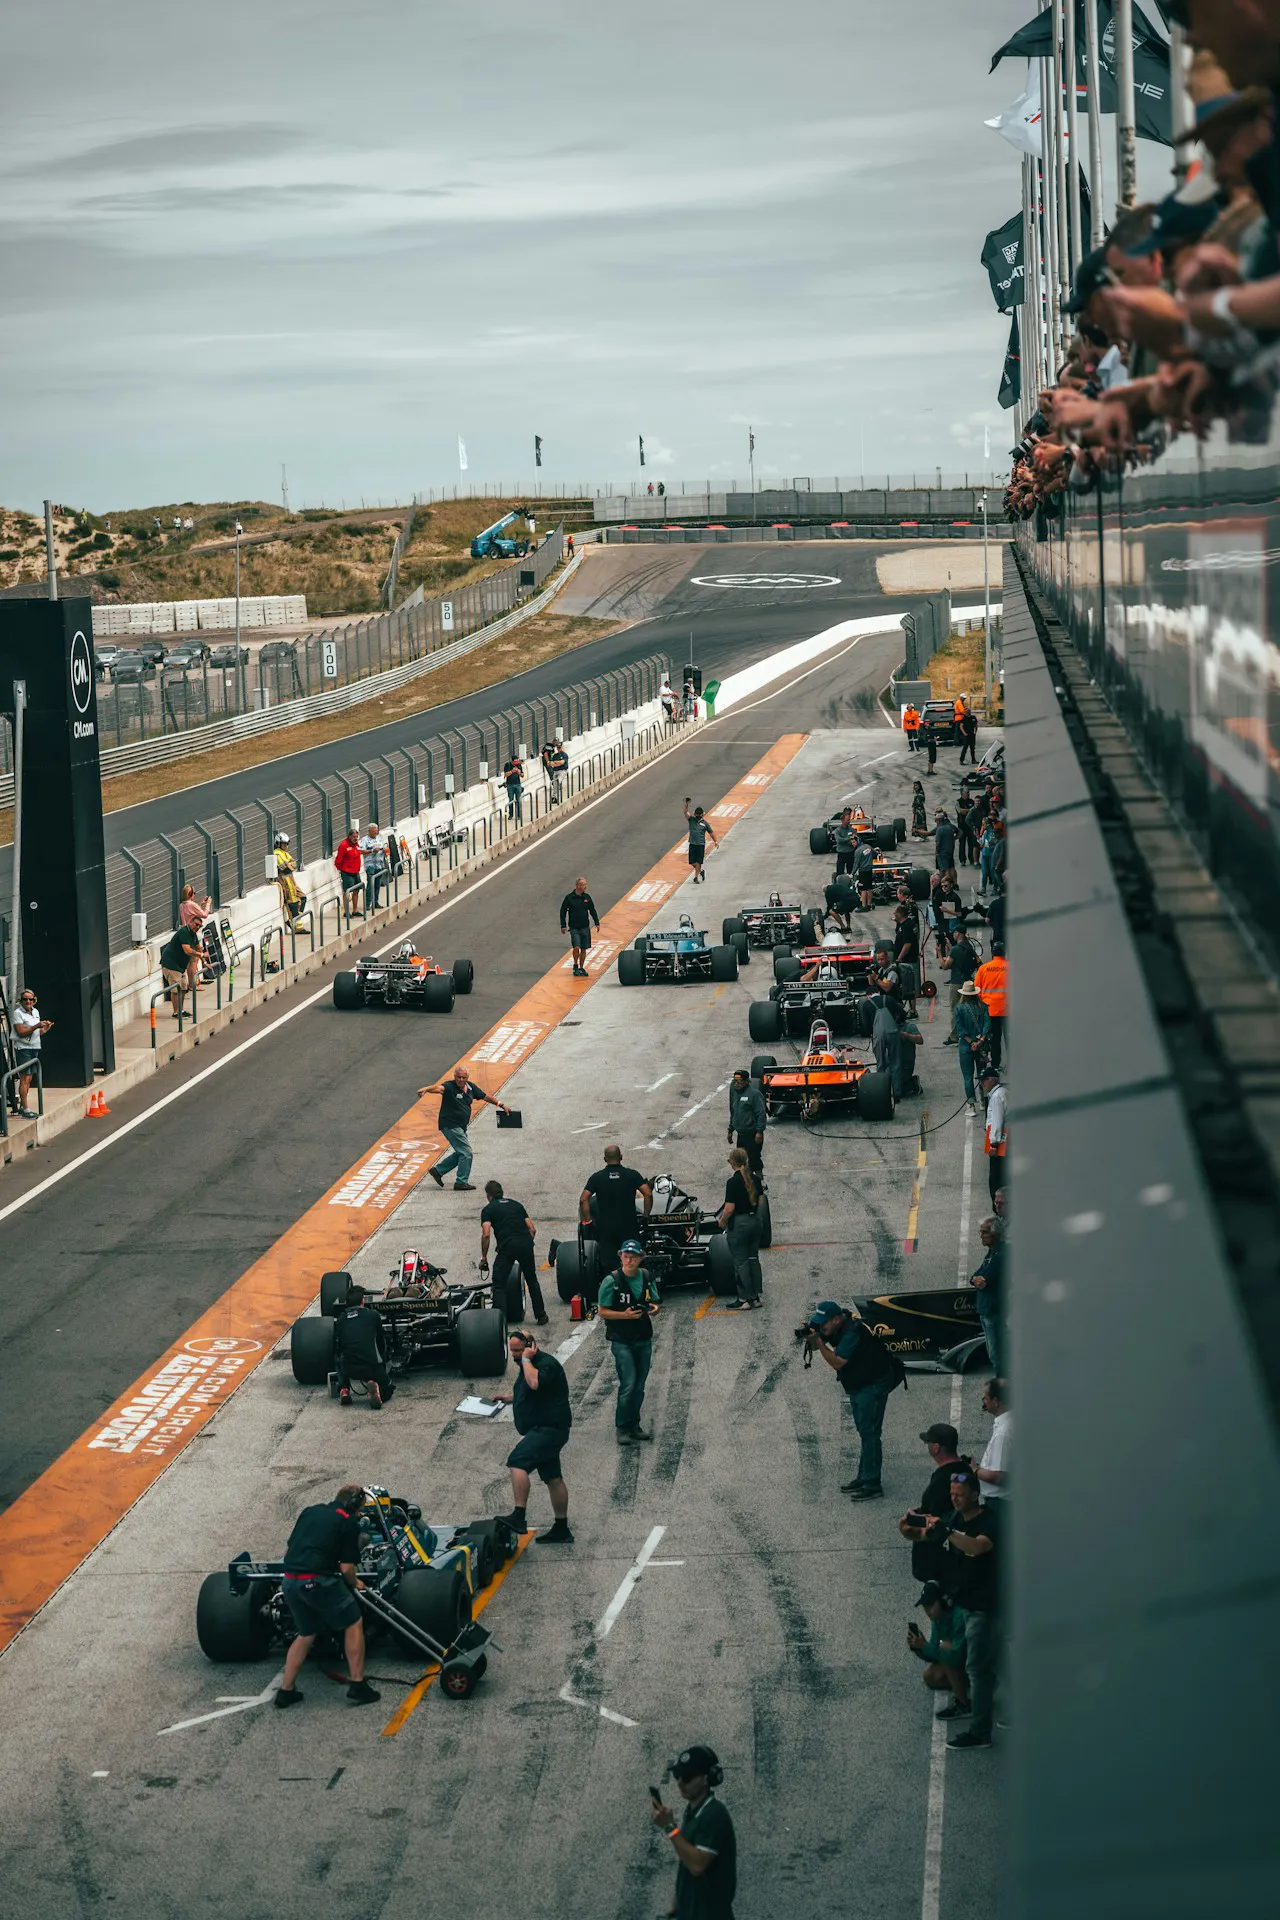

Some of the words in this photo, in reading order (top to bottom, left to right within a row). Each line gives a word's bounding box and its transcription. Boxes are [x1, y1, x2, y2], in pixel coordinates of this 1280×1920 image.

[443, 603, 451, 620] 50
[326, 644, 335, 675] 100
[73, 720, 95, 739] CM.com
[402, 1300, 439, 1309] Special
[619, 1292, 631, 1304] 31
[187, 1357, 246, 1404] CM.COM
[236, 1563, 269, 1574] elf
